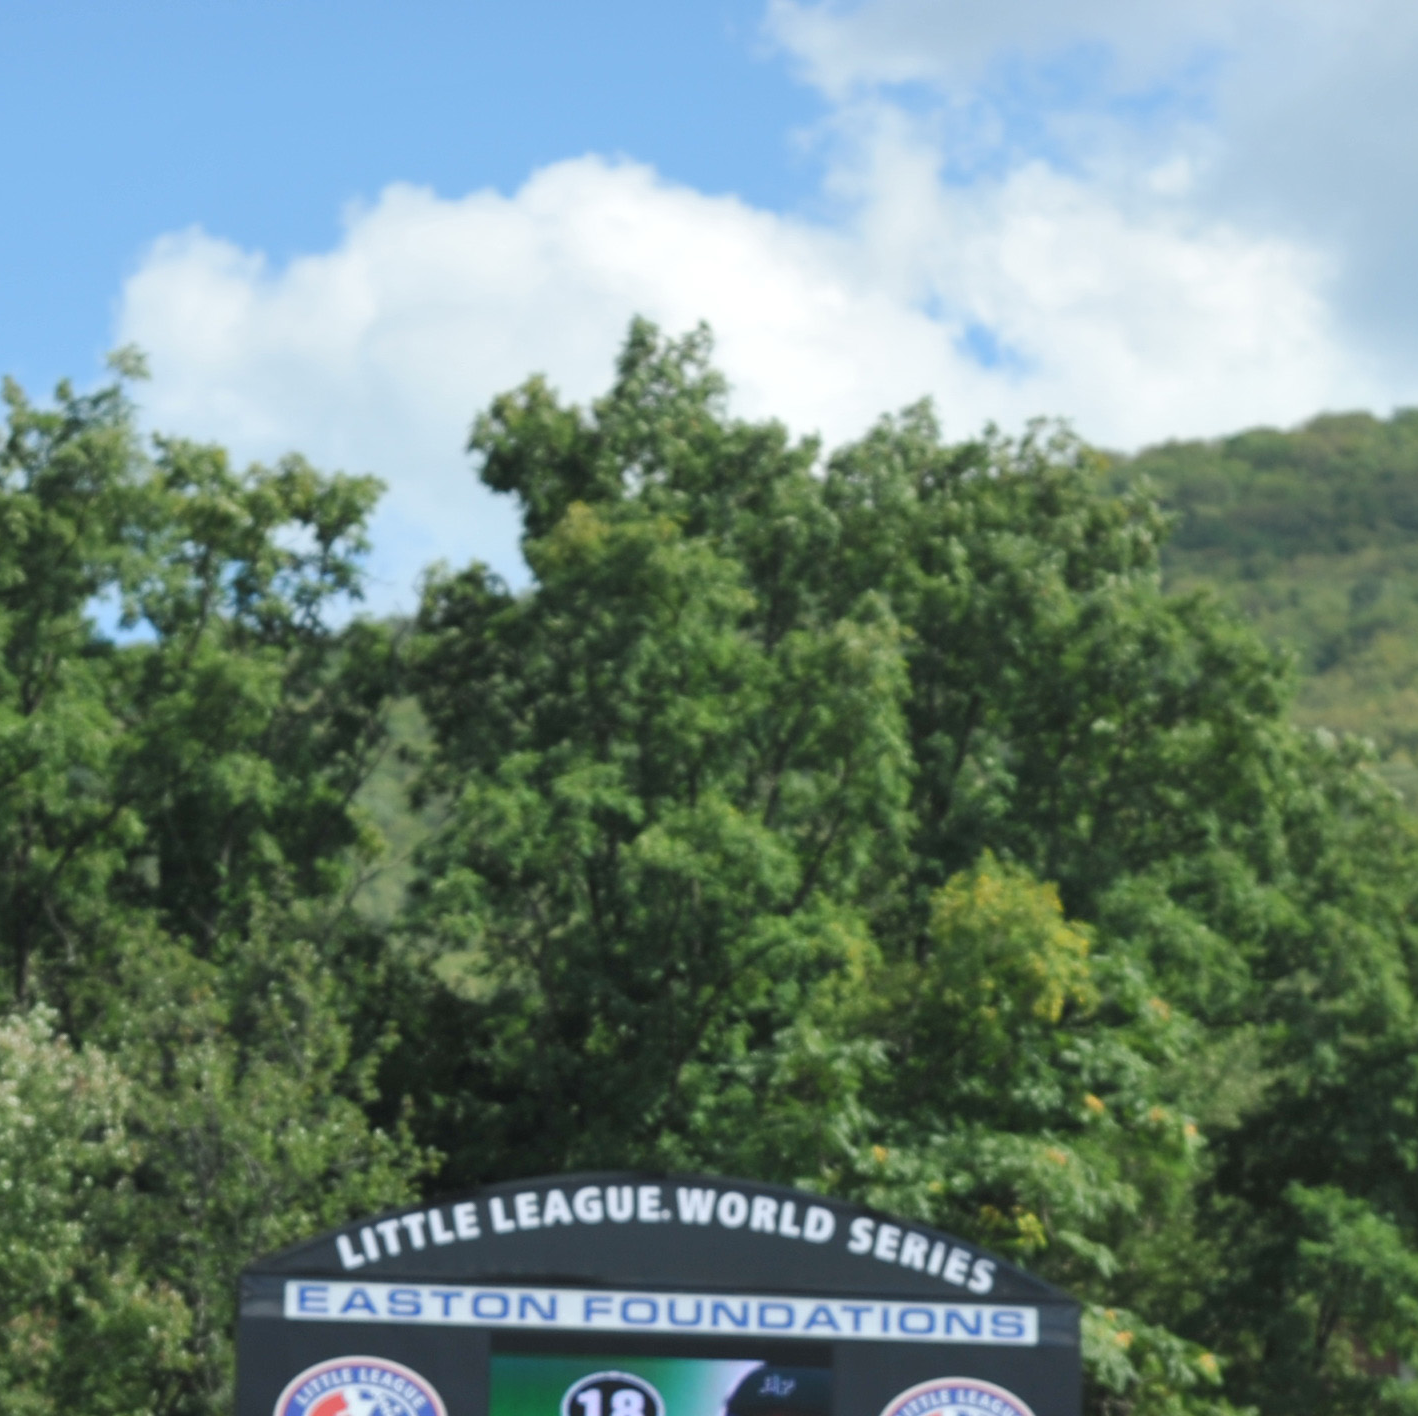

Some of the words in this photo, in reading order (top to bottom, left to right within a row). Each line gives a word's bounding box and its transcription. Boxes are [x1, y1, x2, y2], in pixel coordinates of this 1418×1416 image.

[334, 1213, 482, 1271] LITTLE
[489, 1186, 661, 1234] LEAGUE
[677, 1187, 835, 1244] WORLD
[846, 1216, 998, 1294] SERIES
[296, 1284, 558, 1324] EASTON
[583, 1295, 1027, 1340] FOUNDATIONS
[294, 1367, 352, 1407] LITTLE
[360, 1367, 427, 1410] LEAGUE
